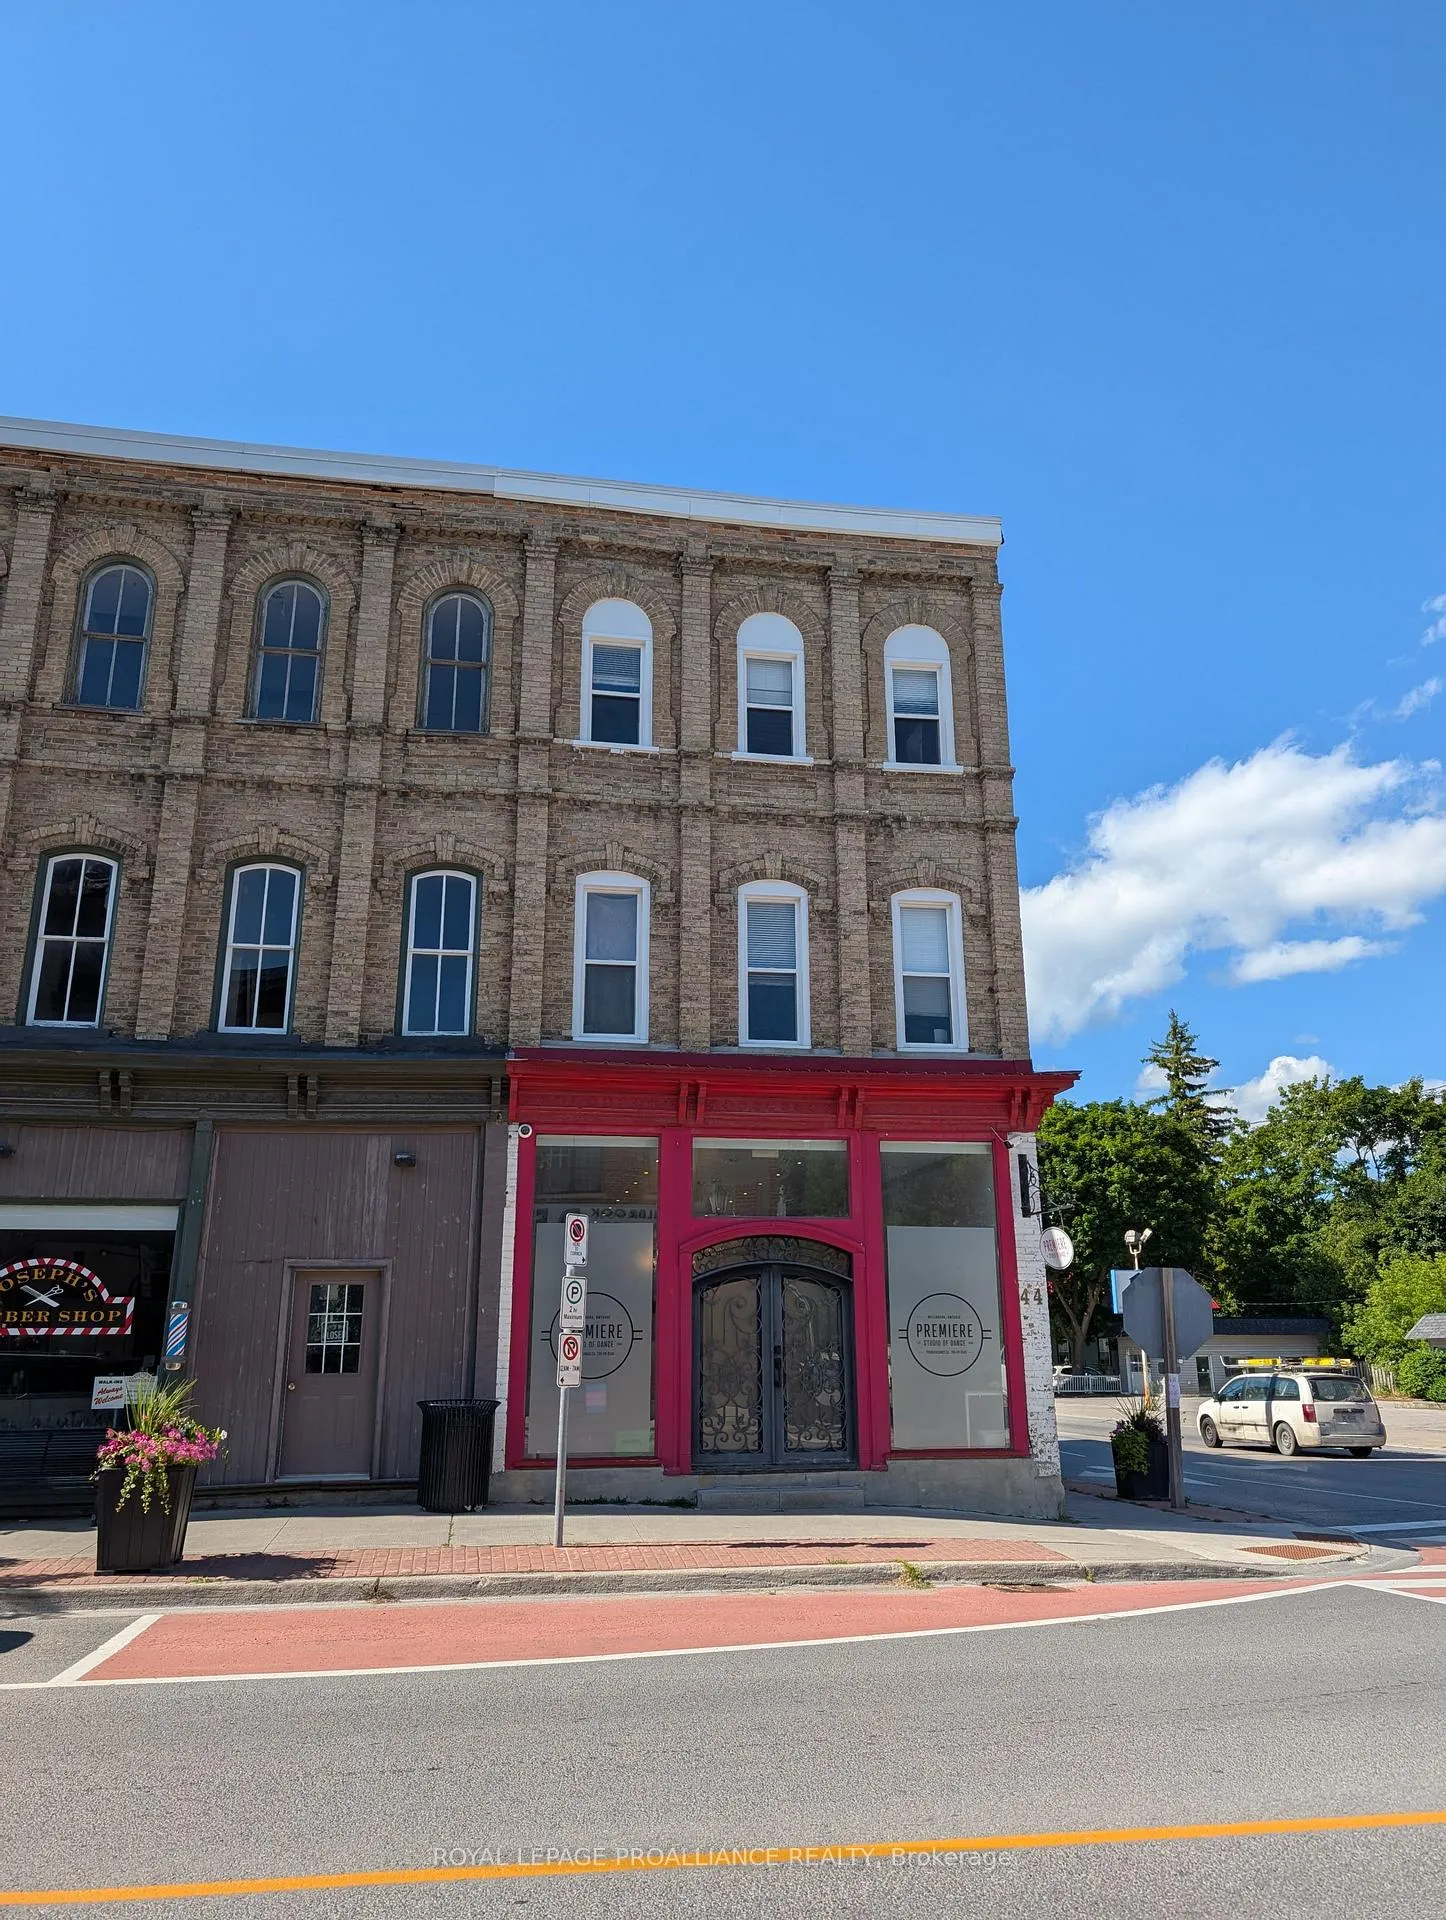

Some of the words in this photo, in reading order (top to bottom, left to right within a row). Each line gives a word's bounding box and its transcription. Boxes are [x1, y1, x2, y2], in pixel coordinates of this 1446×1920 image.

[0, 1268, 98, 1302] OSEPH'S
[571, 1287, 579, 1299] P
[1021, 1288, 1043, 1305] 44
[0, 1311, 50, 1322] BER
[58, 1311, 121, 1322] SHOP
[585, 1324, 623, 1338] MIERE
[916, 1324, 973, 1338] PREMIERE
[97, 1387, 123, 1396] Always
[94, 1394, 123, 1405] Welcome
